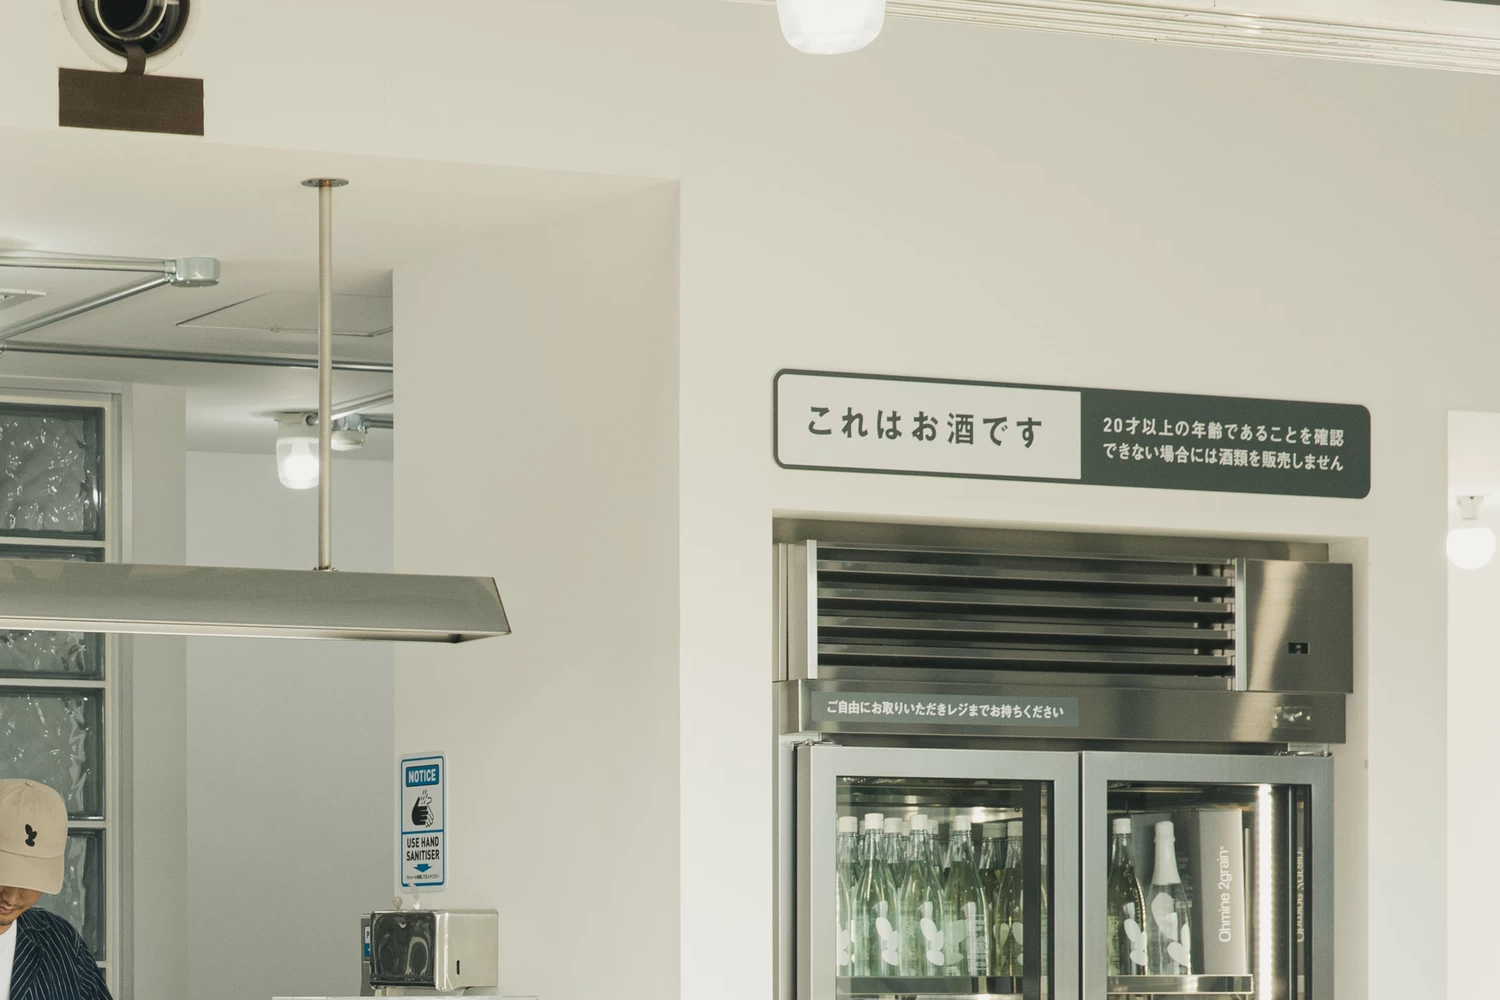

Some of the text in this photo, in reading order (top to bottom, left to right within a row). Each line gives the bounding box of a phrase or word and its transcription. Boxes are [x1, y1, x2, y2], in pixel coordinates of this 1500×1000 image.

[806, 404, 1045, 449] これはお酒です
[1102, 415, 1346, 448] 20才以上の年齢であることを確認
[1101, 441, 1345, 471] できない場合には酒類を販売しません
[826, 699, 1065, 720] ご自由にお取りいただきレジまでお持ちください
[408, 768, 437, 784] NOTICE
[406, 836, 440, 849] USE HAND
[406, 848, 440, 862] SANITISER
[1218, 893, 1231, 943] Ohmine
